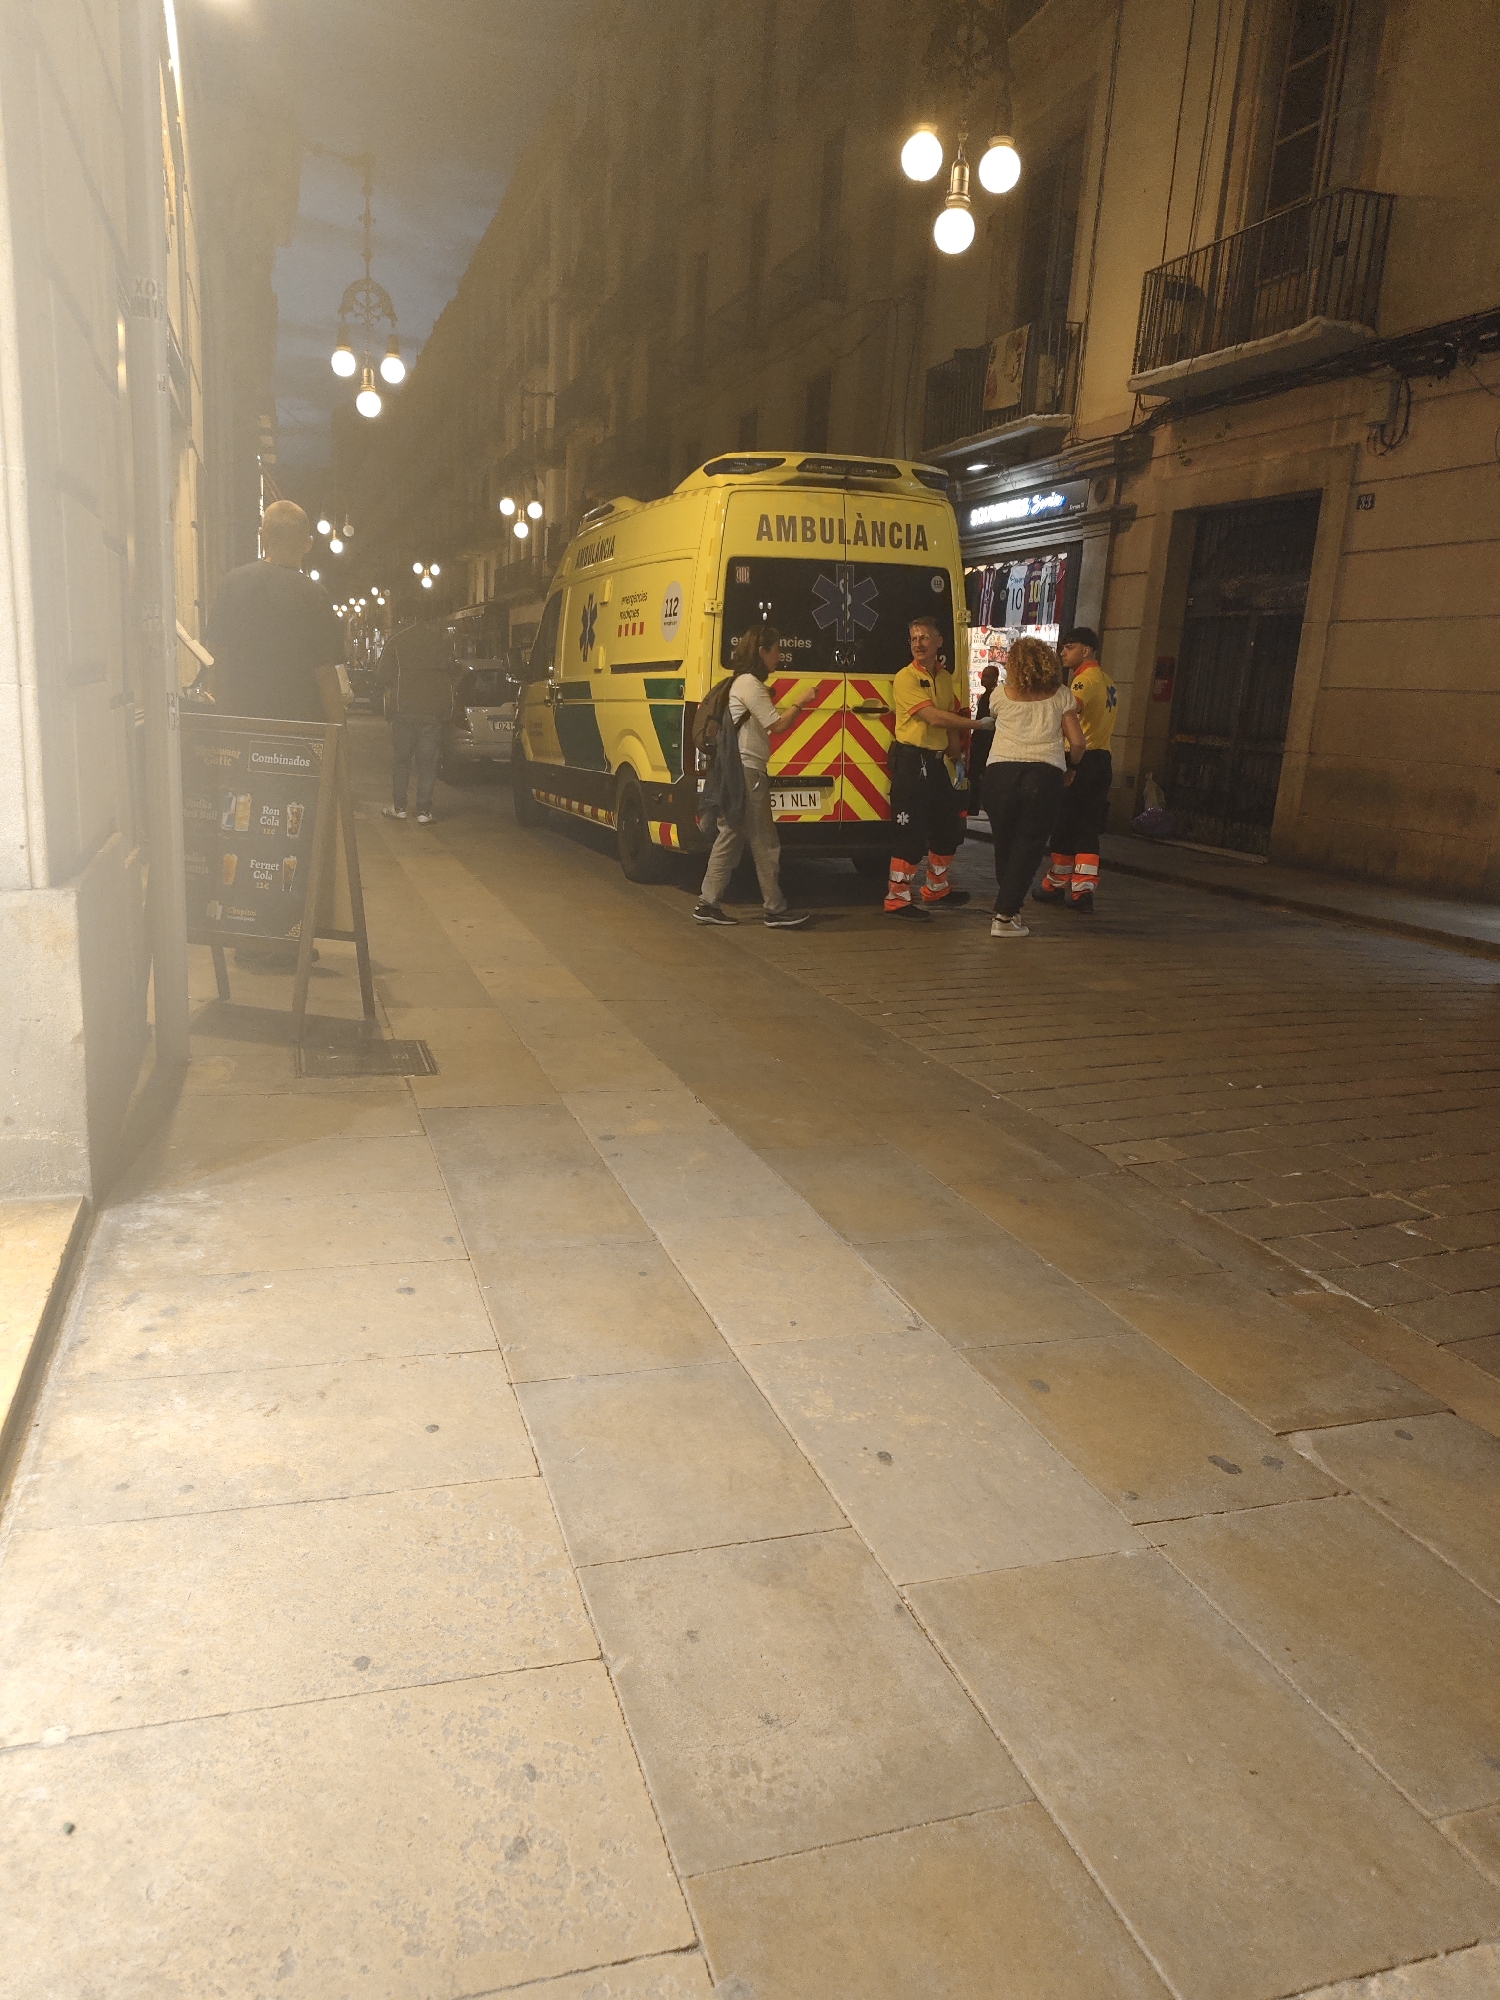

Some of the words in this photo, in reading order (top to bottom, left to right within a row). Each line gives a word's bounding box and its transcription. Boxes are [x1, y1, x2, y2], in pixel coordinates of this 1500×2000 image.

[756, 512, 929, 552] AMBULÀNCIA
[575, 535, 616, 569] AMBULÀNCIA
[1011, 588, 1023, 610] 10
[1029, 580, 1041, 603] 10
[664, 597, 679, 618] 112
[251, 752, 311, 767] Combinados
[791, 793, 817, 808] NLN
[262, 805, 280, 816] Ron
[259, 815, 280, 827] Cola
[249, 859, 280, 871] Fernet
[253, 870, 273, 881] Cola
